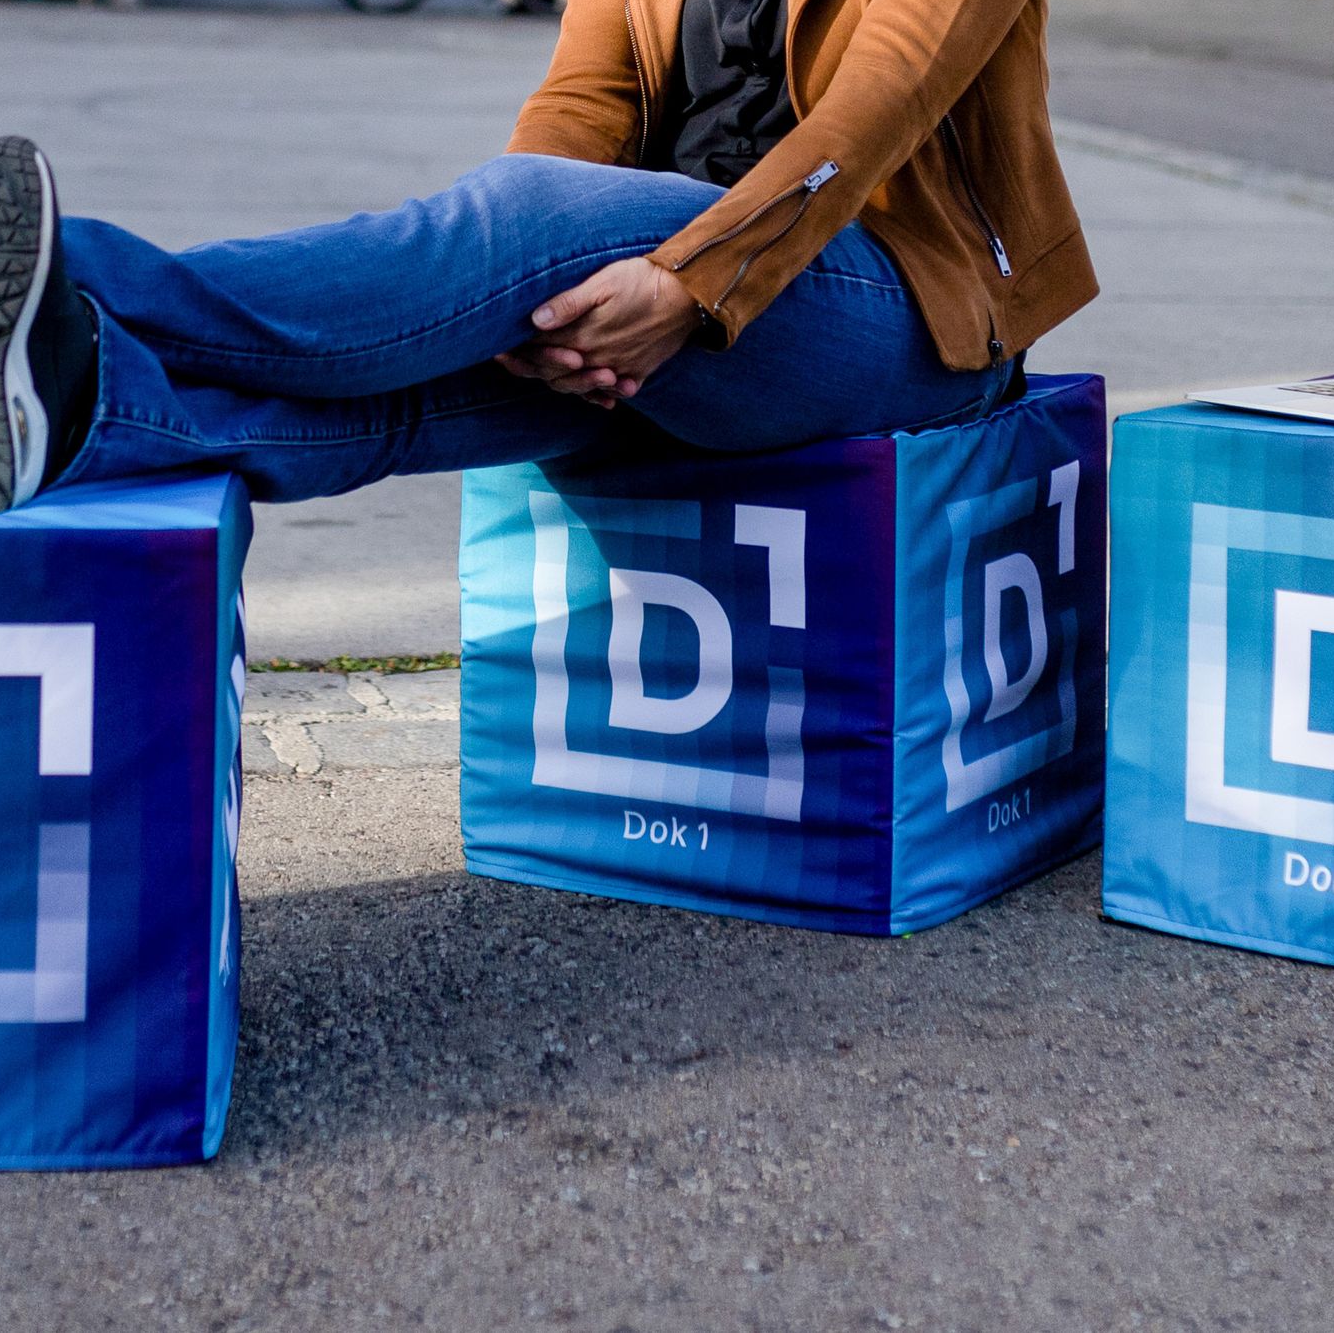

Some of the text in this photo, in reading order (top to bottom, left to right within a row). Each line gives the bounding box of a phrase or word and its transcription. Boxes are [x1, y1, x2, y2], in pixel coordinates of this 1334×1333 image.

[623, 810, 709, 851] Dok 1
[988, 786, 1031, 834] Dok 1
